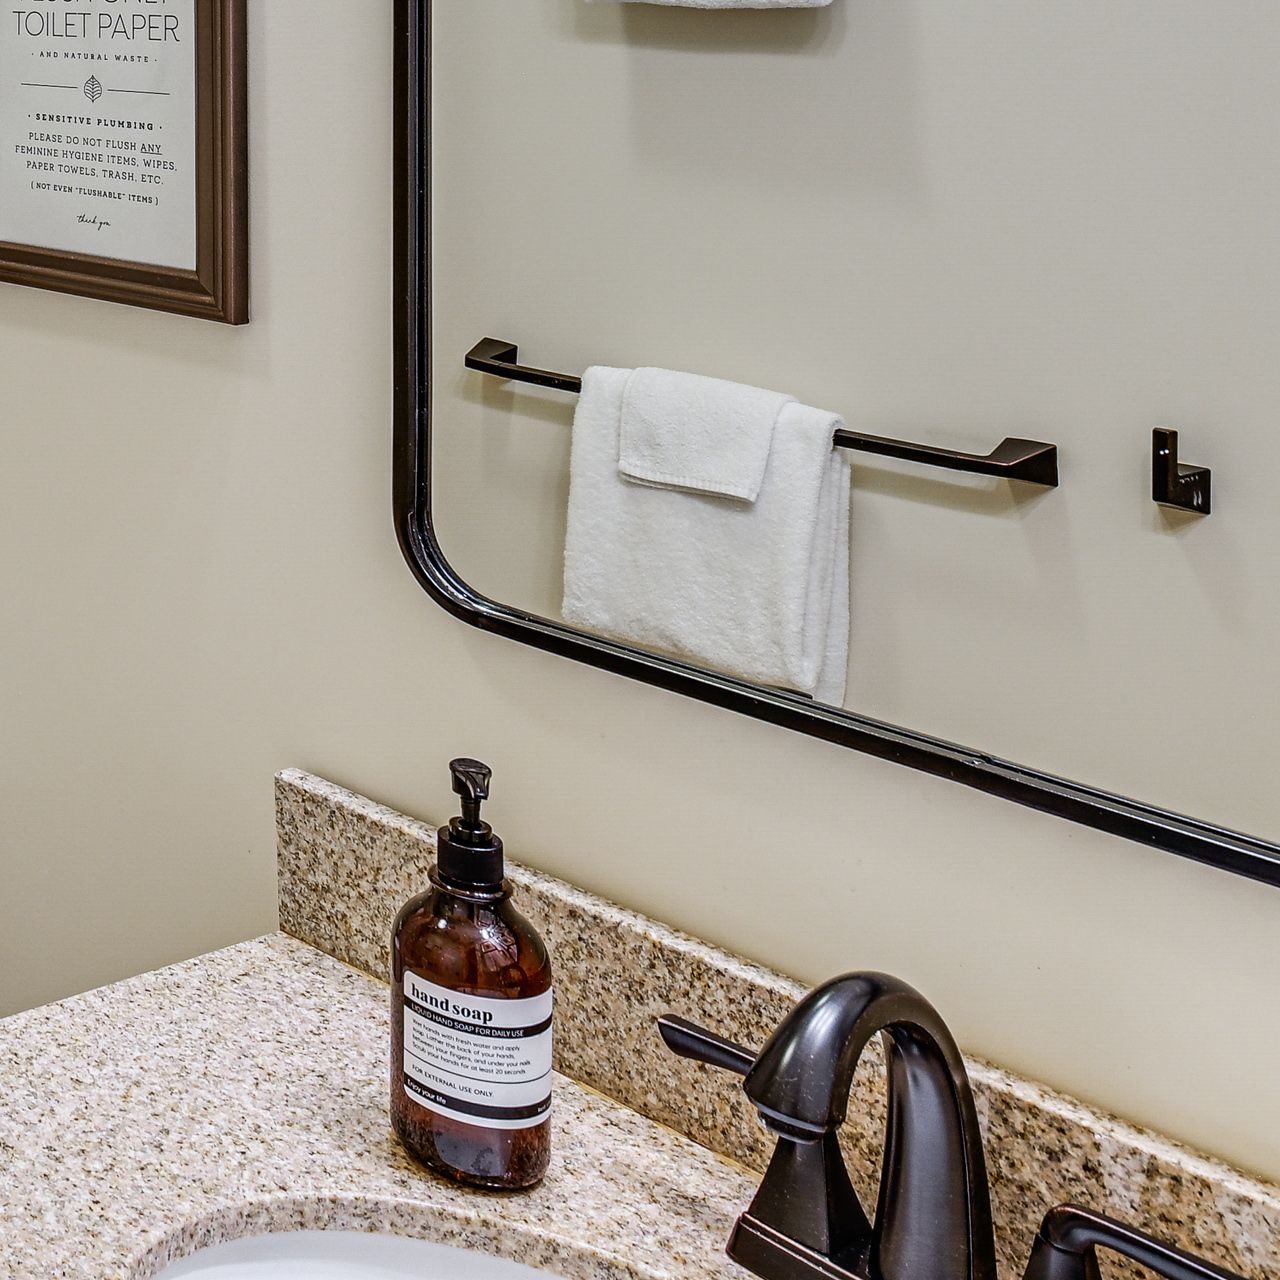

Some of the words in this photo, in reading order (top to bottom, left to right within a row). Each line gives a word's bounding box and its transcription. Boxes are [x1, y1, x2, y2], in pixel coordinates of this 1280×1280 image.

[12, 10, 91, 38] TOILET
[98, 13, 180, 42] PAPER
[64, 52, 109, 61] NATURAL
[114, 54, 149, 63] WASTE
[35, 113, 91, 125] SENSITIVE
[97, 119, 154, 131] PLUMBING
[28, 132, 63, 143] PLEASE
[66, 135, 79, 145] DO
[82, 137, 102, 148] NOT
[105, 139, 137, 151] FLUSH
[140, 143, 162, 154] ANY
[15, 145, 59, 157] FEMININE
[62, 150, 104, 163] HYGIENE
[107, 155, 139, 168] ITEMS,
[26, 161, 55, 171] PAPER
[57, 164, 99, 178] TOWELS,
[102, 169, 138, 182] TRASH,
[141, 174, 164, 185] ETC.
[53, 184, 73, 193] EVEN
[411, 982, 450, 1012] hand
[452, 1004, 493, 1025] soap
[411, 1002, 432, 1018] LIQUID
[432, 1013, 453, 1027] HAND
[454, 1022, 474, 1032] SOAP
[475, 1027, 491, 1035] FOR
[491, 1029, 511, 1037] DAILY
[511, 1030, 524, 1038] USE
[412, 1064, 423, 1075] FOR
[424, 1072, 457, 1090] EXTERNAL
[459, 1085, 472, 1093] USE
[421, 1089, 436, 1099] your
